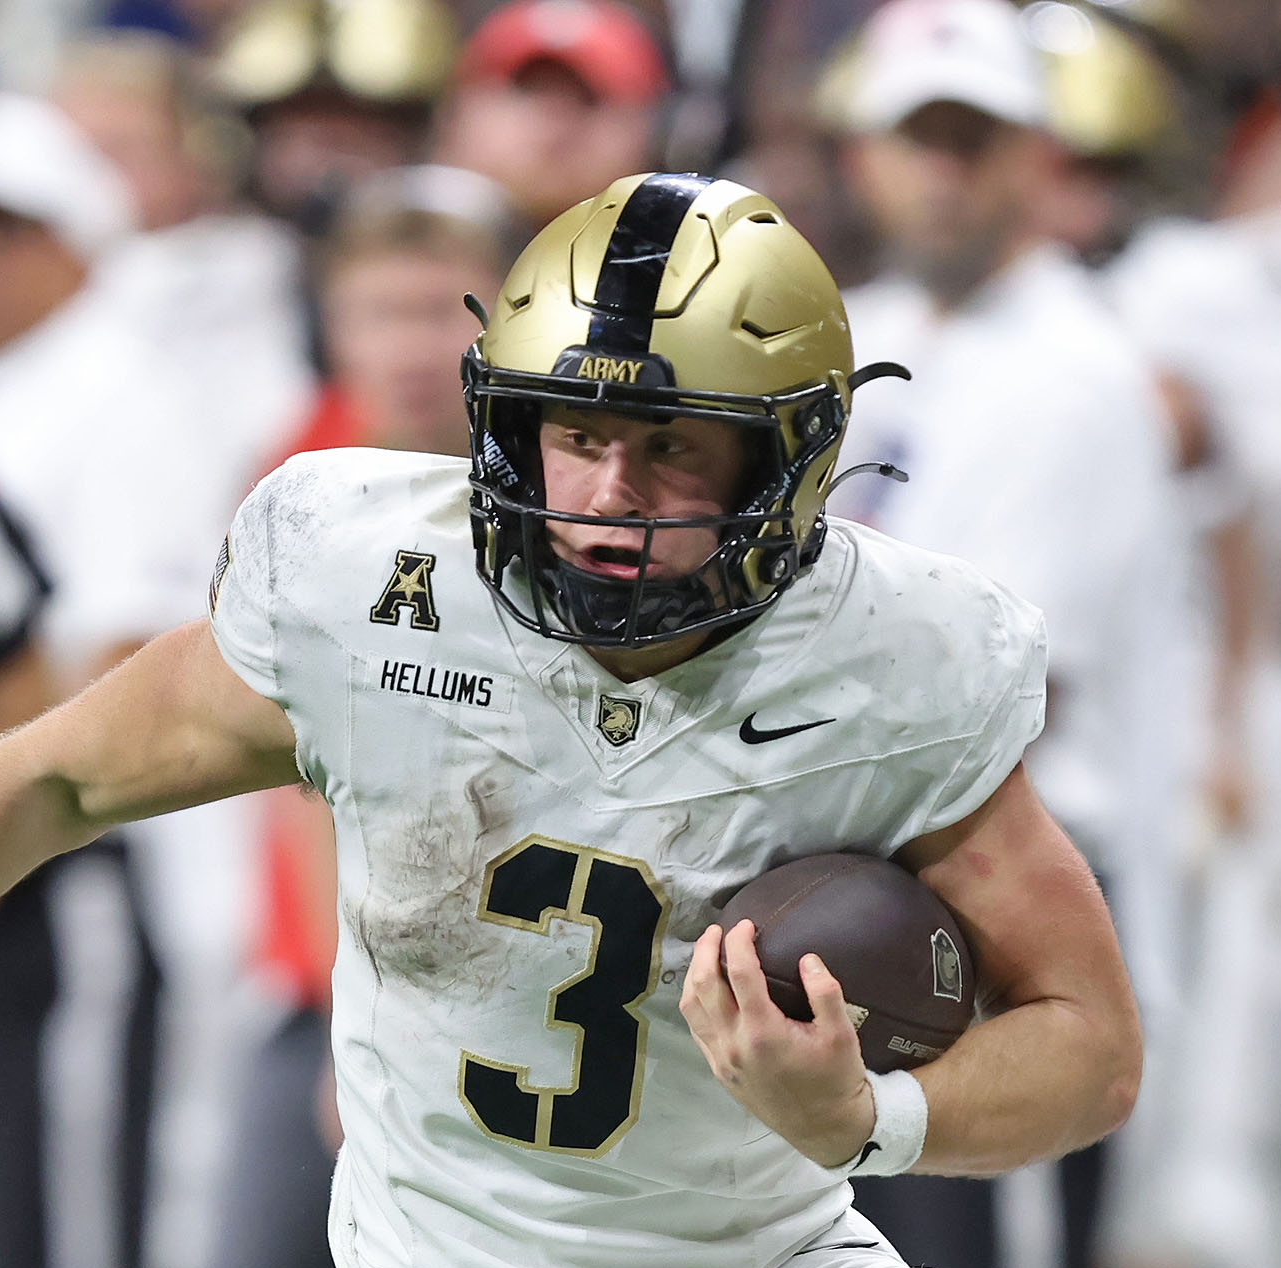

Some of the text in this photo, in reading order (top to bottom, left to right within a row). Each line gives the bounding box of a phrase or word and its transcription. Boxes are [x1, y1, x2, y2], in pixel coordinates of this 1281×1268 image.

[577, 356, 643, 384] ARMY
[370, 549, 440, 632] A
[381, 660, 493, 706] HELLUMS
[457, 832, 672, 1159] 3
